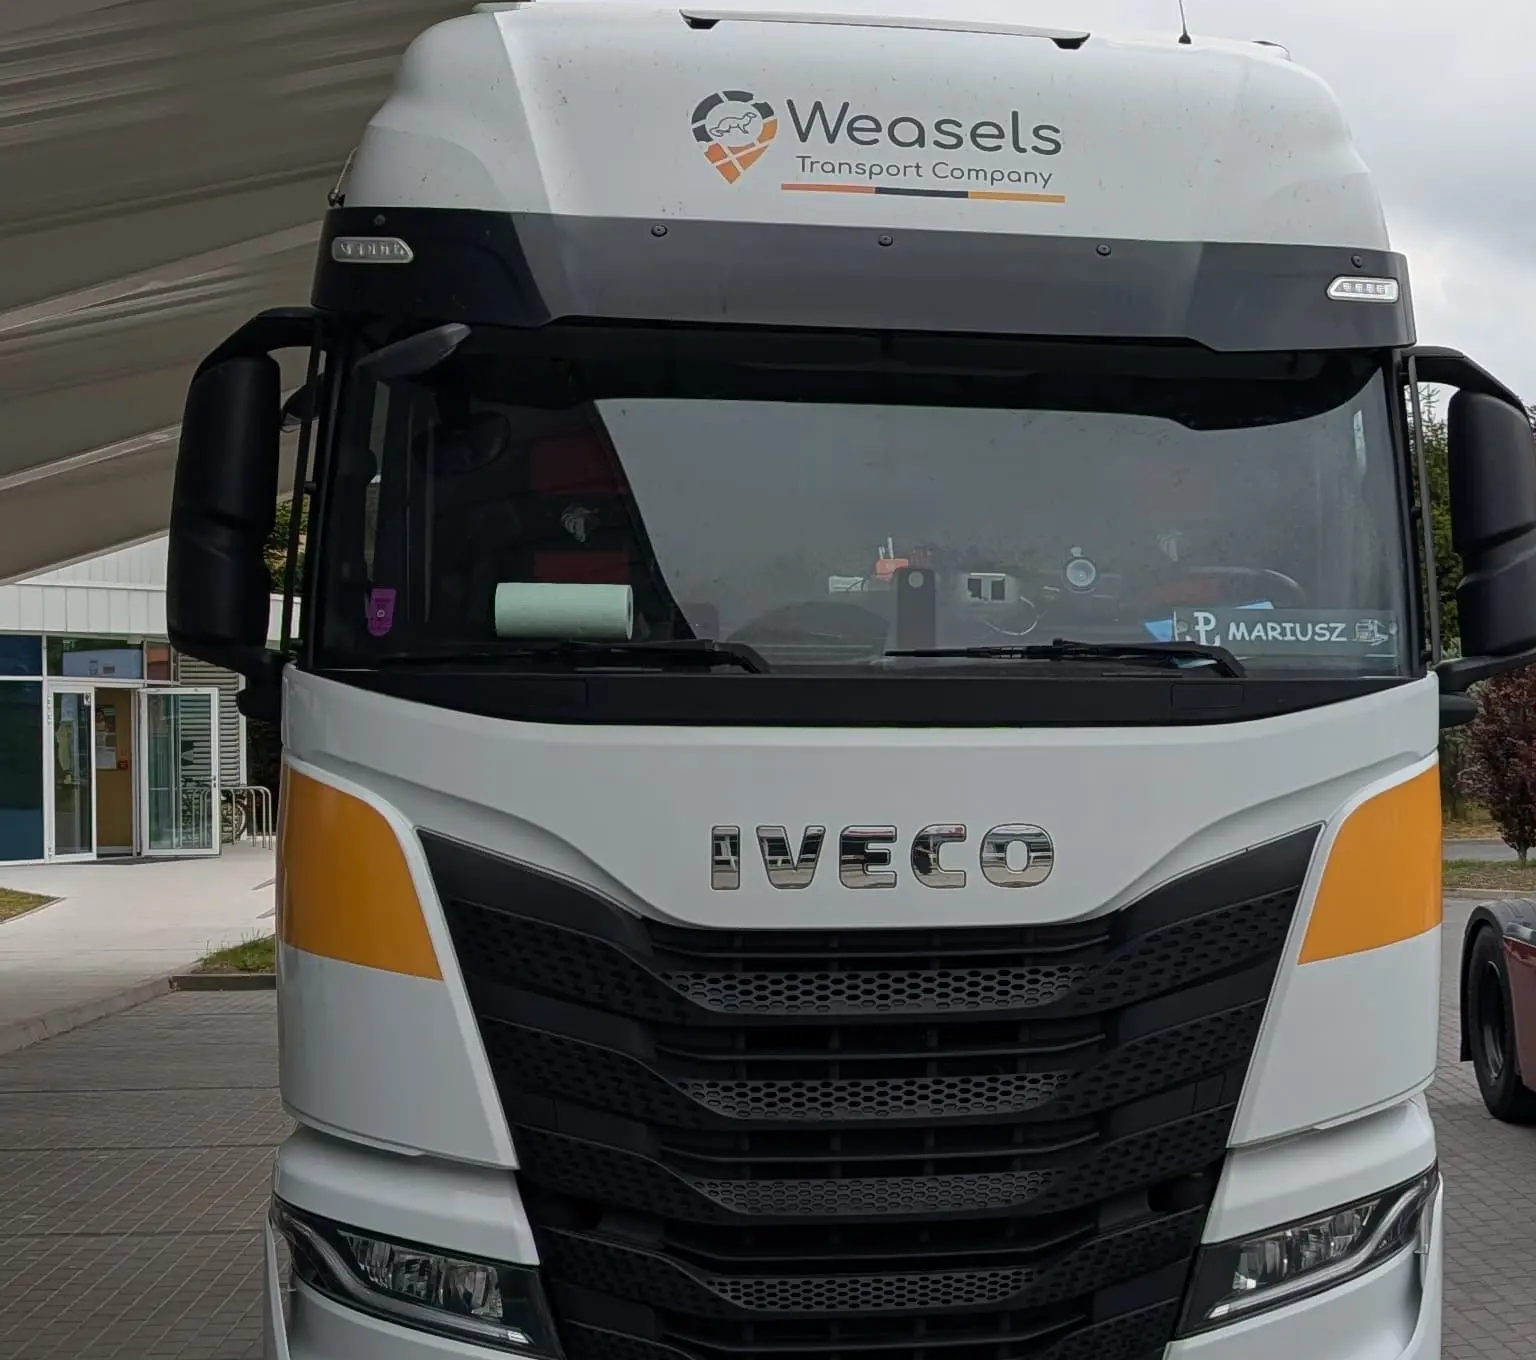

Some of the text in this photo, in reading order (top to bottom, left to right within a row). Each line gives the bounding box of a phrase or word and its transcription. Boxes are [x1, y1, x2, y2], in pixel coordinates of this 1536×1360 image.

[786, 98, 1064, 156] Weasels
[796, 156, 1054, 188] Transport Company
[1228, 621, 1348, 642] MARIUSZ
[710, 822, 1055, 891] IVECO
